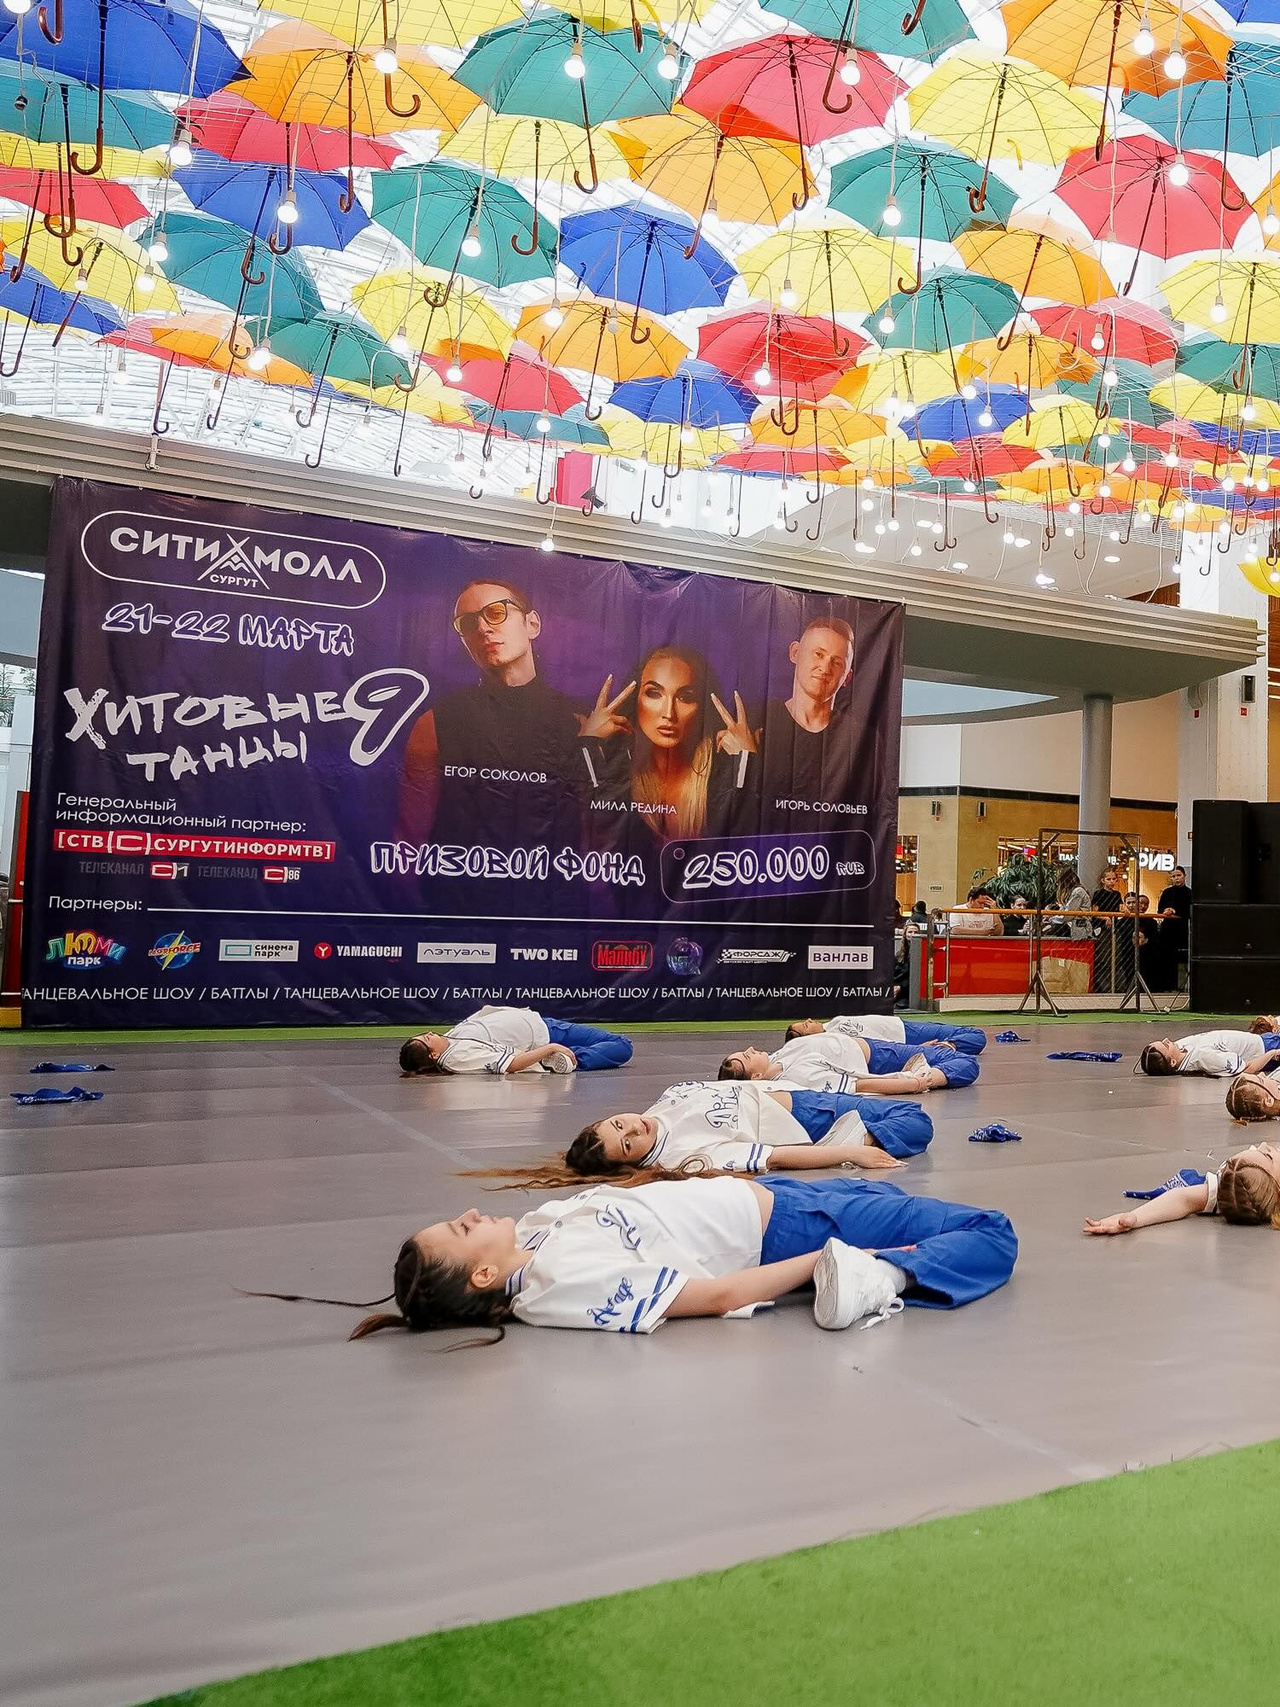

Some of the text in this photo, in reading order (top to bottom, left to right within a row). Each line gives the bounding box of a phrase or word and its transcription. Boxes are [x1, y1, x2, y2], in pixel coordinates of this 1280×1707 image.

[110, 527, 362, 584] СИТИ МОЛЛ
[210, 573, 258, 588] СУРГУТ
[102, 602, 355, 656] 21-22 МАРТА
[127, 729, 308, 781] ТАНЦЫ
[444, 765, 547, 784] ЕГОР СОКОЛОВ
[57, 792, 176, 811] Генеральный
[590, 800, 678, 815] МИЛА РЕДИНА
[775, 799, 868, 815] ИГОРЬ СОЛОВЬЕВ
[56, 809, 306, 834] информационный партнер:
[79, 861, 144, 875] ТЕЛЕКАНАЛ
[198, 865, 258, 879] ТЕЛЕКАНАЛ
[370, 841, 549, 882] ПРИЗОВОЙ
[553, 850, 646, 887] ФОНД
[682, 845, 830, 890] 250.000
[49, 895, 142, 912] Партнеры:
[254, 951, 281, 959] парк
[336, 945, 402, 957] YAMAGUCHI
[511, 948, 578, 961] TWO KEI
[813, 952, 869, 963] ванлав
[67, 956, 101, 967] парк
[153, 987, 194, 1000] ШОУ
[210, 987, 269, 1000] БАТТЛЫ
[284, 987, 399, 1001] ТАНЦЕВАЛЬНОЕ
[404, 987, 439, 1000] ШОУ
[453, 987, 502, 999] БАТТЛЫ
[515, 987, 617, 1000] ТАНЦЕВАЛЬНОЕ
[620, 987, 650, 999] ШОУ
[661, 987, 704, 999] БАТТЛЫ
[715, 986, 802, 1000] ТАНЦЕВАЛЬНОЕ
[806, 986, 833, 998] ШОУ
[842, 986, 882, 998] БАТТЛЫ
